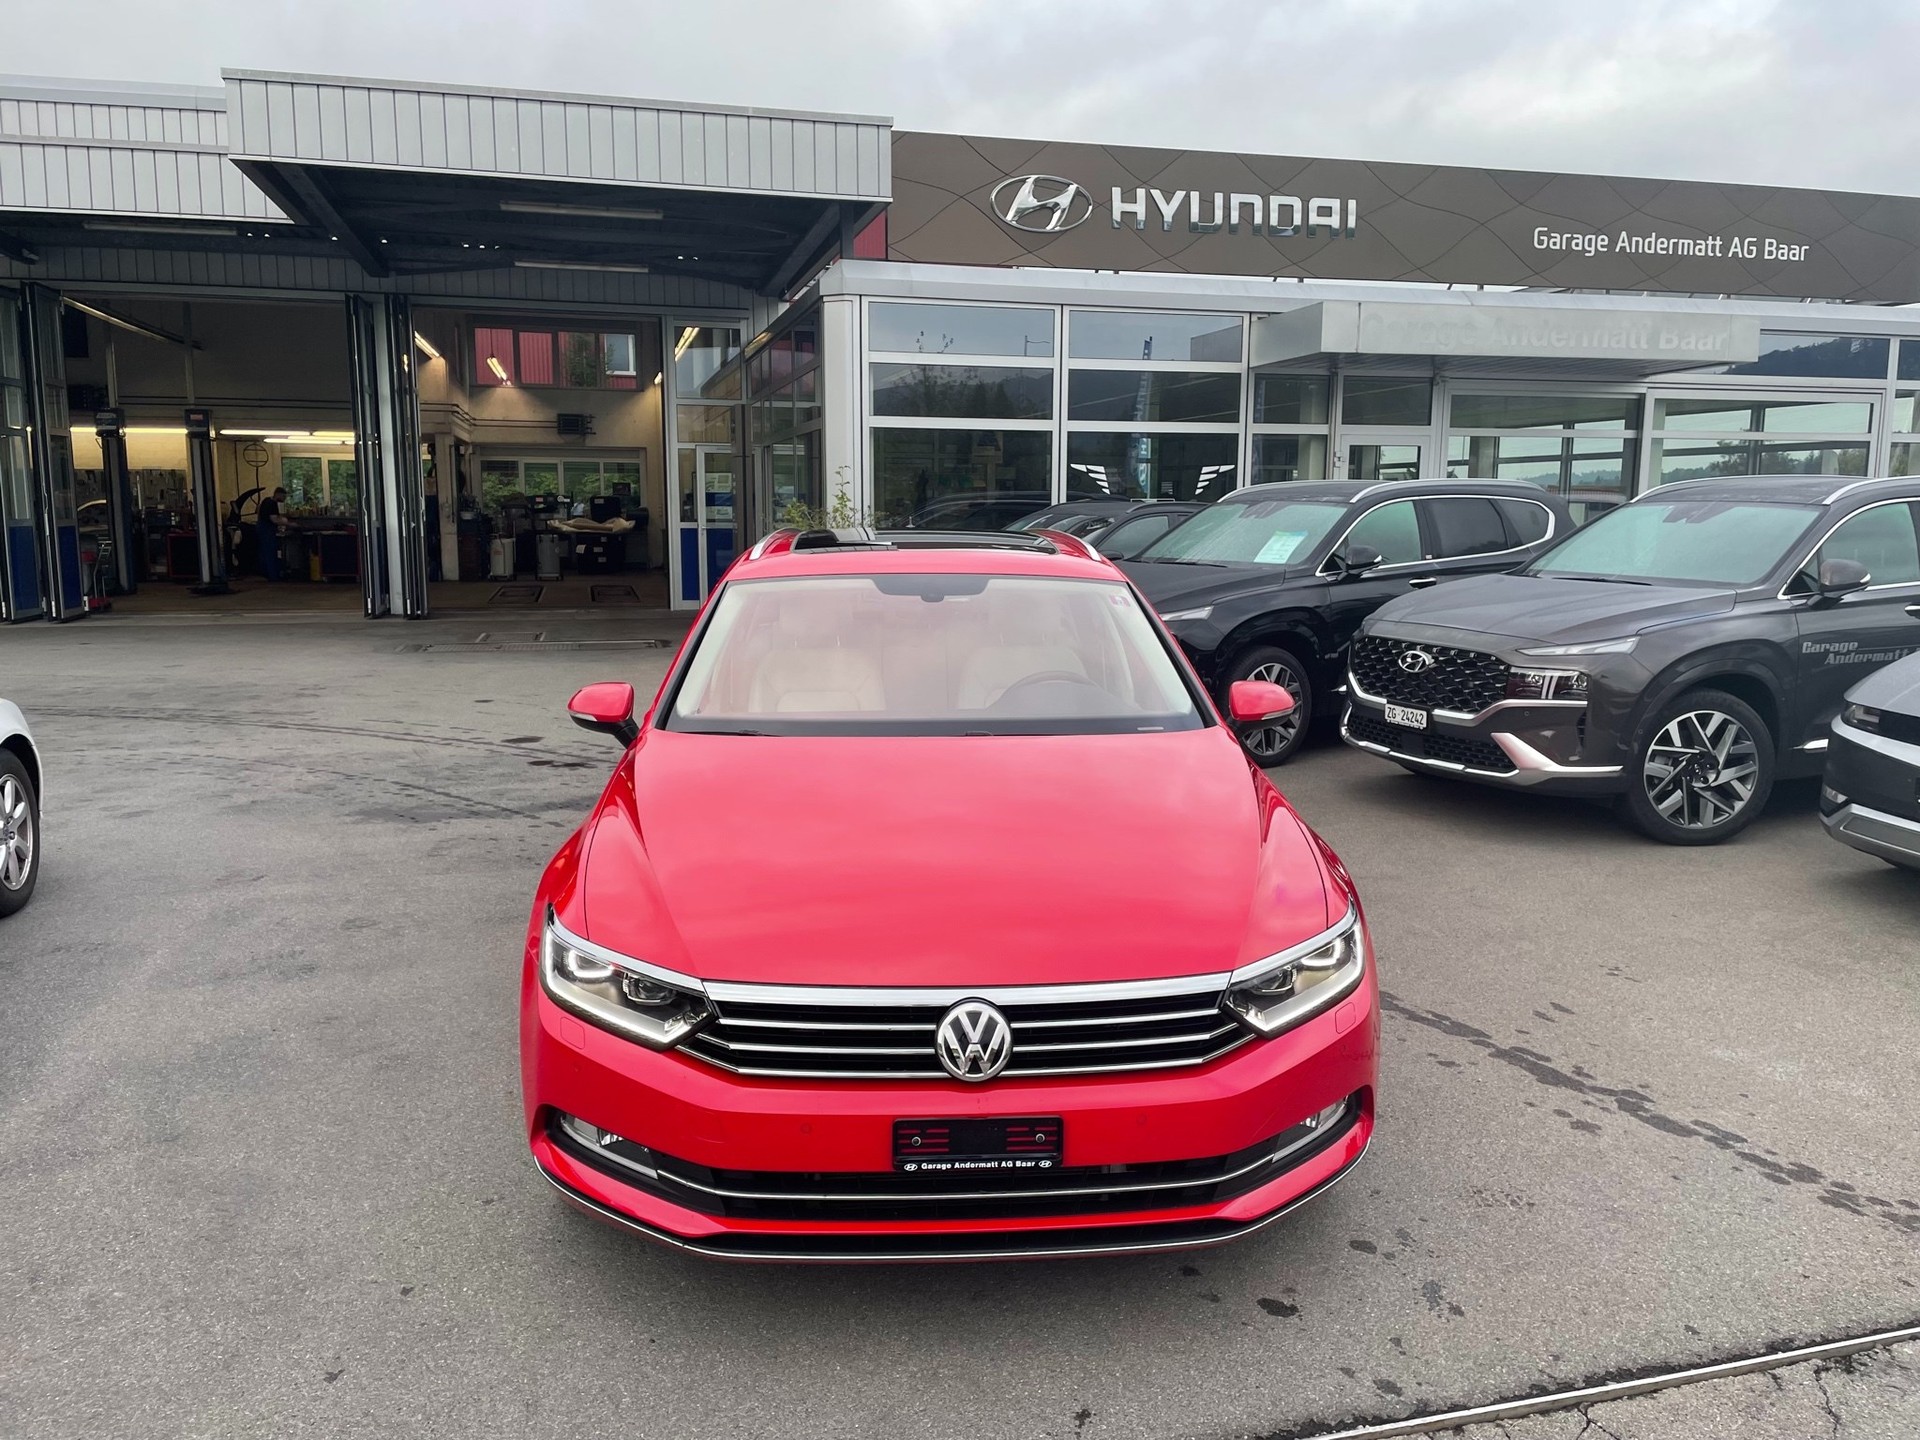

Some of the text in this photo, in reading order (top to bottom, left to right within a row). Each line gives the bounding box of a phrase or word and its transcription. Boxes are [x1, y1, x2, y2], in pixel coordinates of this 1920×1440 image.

[1110, 186, 1358, 238] HYUNDAI
[1533, 226, 1809, 262] Garage Andermatt AG Baar
[1488, 316, 1649, 350] Andermatt
[1658, 324, 1729, 352] Baar
[1802, 641, 1858, 653] Garage
[1824, 648, 1909, 664] Andermatt
[921, 1159, 1036, 1171] Garage Andermatt AG Baar
